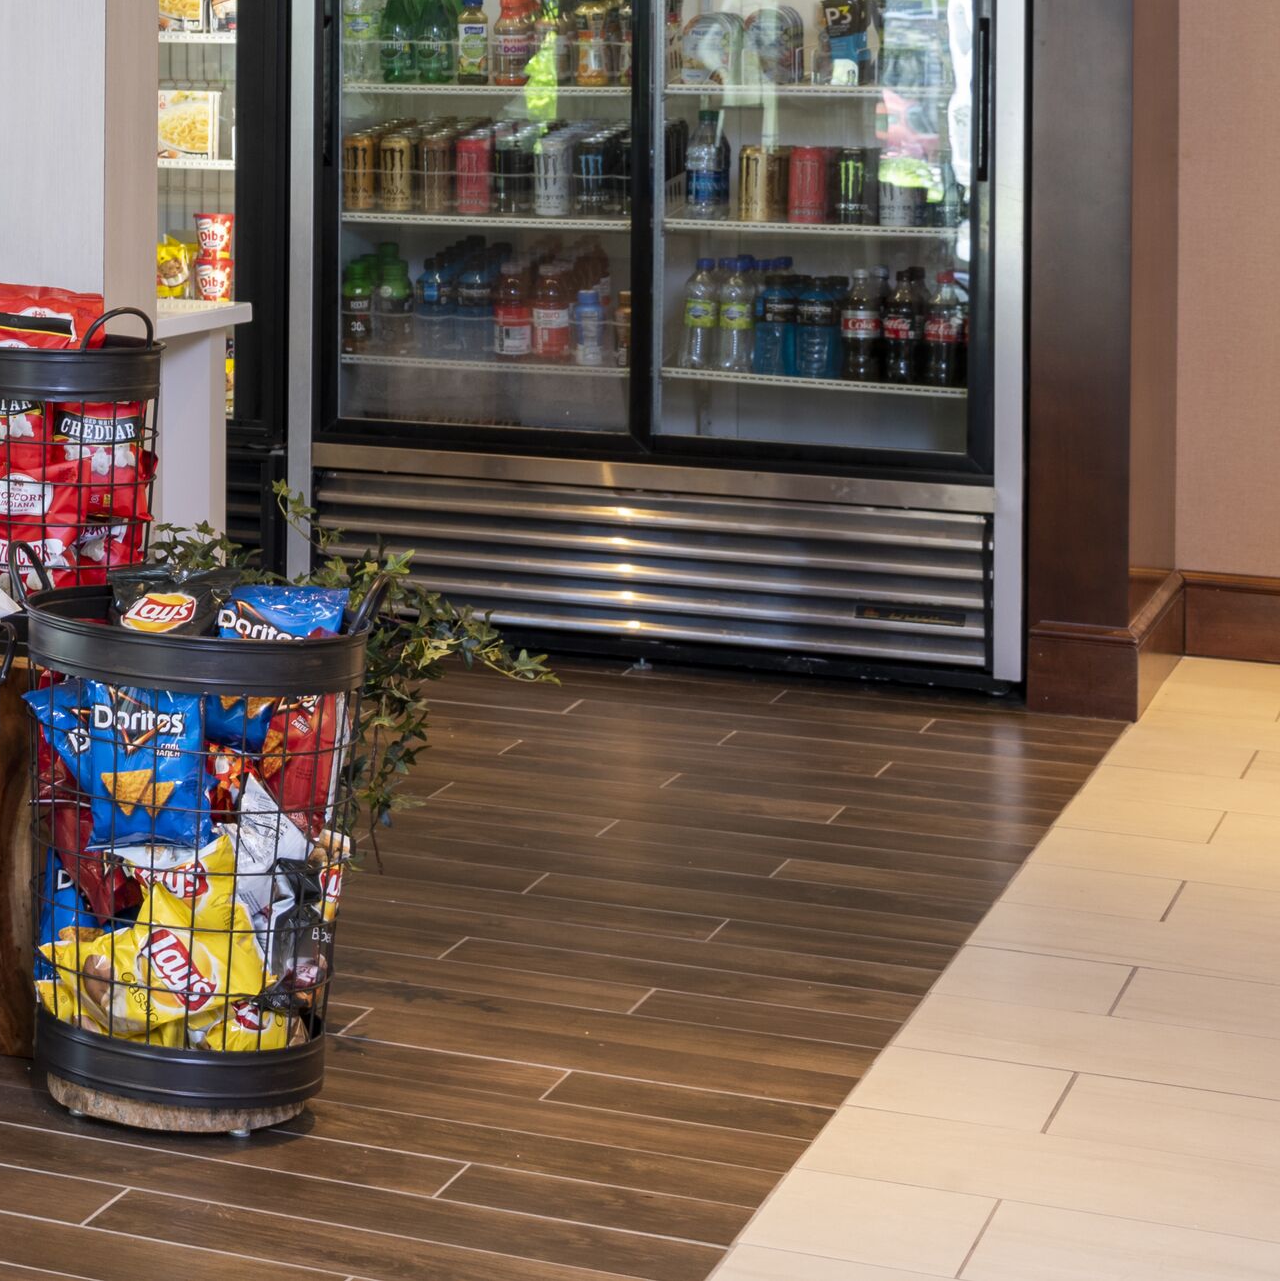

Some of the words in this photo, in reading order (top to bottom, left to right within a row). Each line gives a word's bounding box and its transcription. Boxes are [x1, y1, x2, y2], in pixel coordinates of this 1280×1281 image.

[825, 6, 852, 26] P3
[200, 229, 225, 243] Dibs
[200, 275, 225, 289] Dibs
[848, 319, 875, 331] Coke
[60, 416, 136, 443] CHEDDAR
[127, 596, 196, 623] Lay's
[93, 704, 184, 735] Doritos
[142, 930, 217, 1004] Lay's
